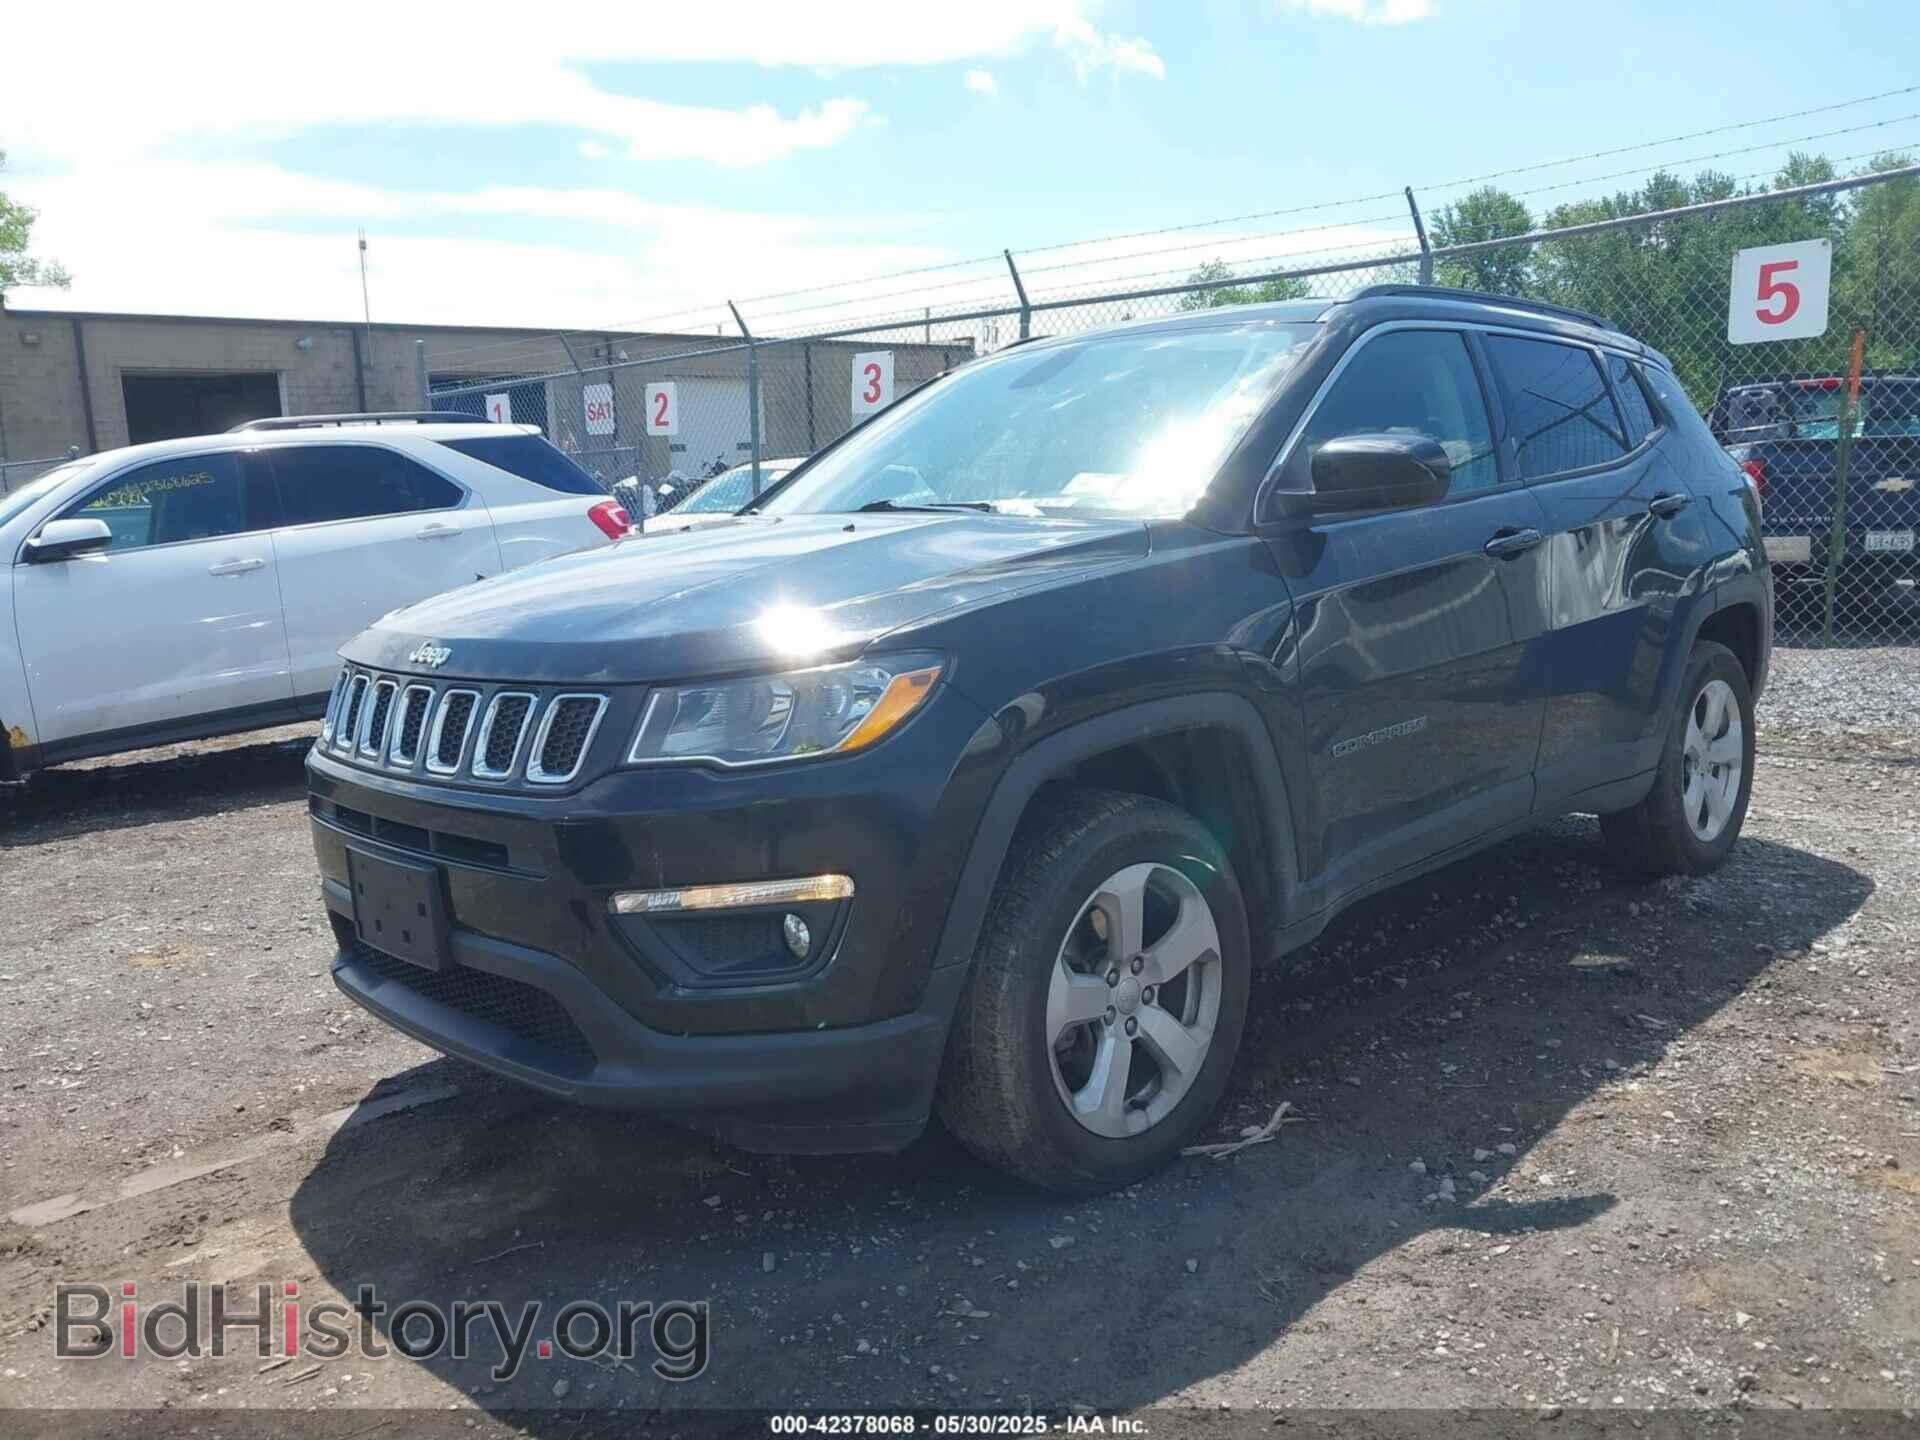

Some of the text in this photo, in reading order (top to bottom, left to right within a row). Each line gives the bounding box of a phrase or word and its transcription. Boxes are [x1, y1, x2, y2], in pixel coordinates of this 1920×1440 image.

[1755, 259, 1801, 326] 5
[864, 362, 883, 404] 3
[493, 403, 502, 424] 1
[654, 392, 670, 427] 2
[409, 640, 452, 669] Jeep
